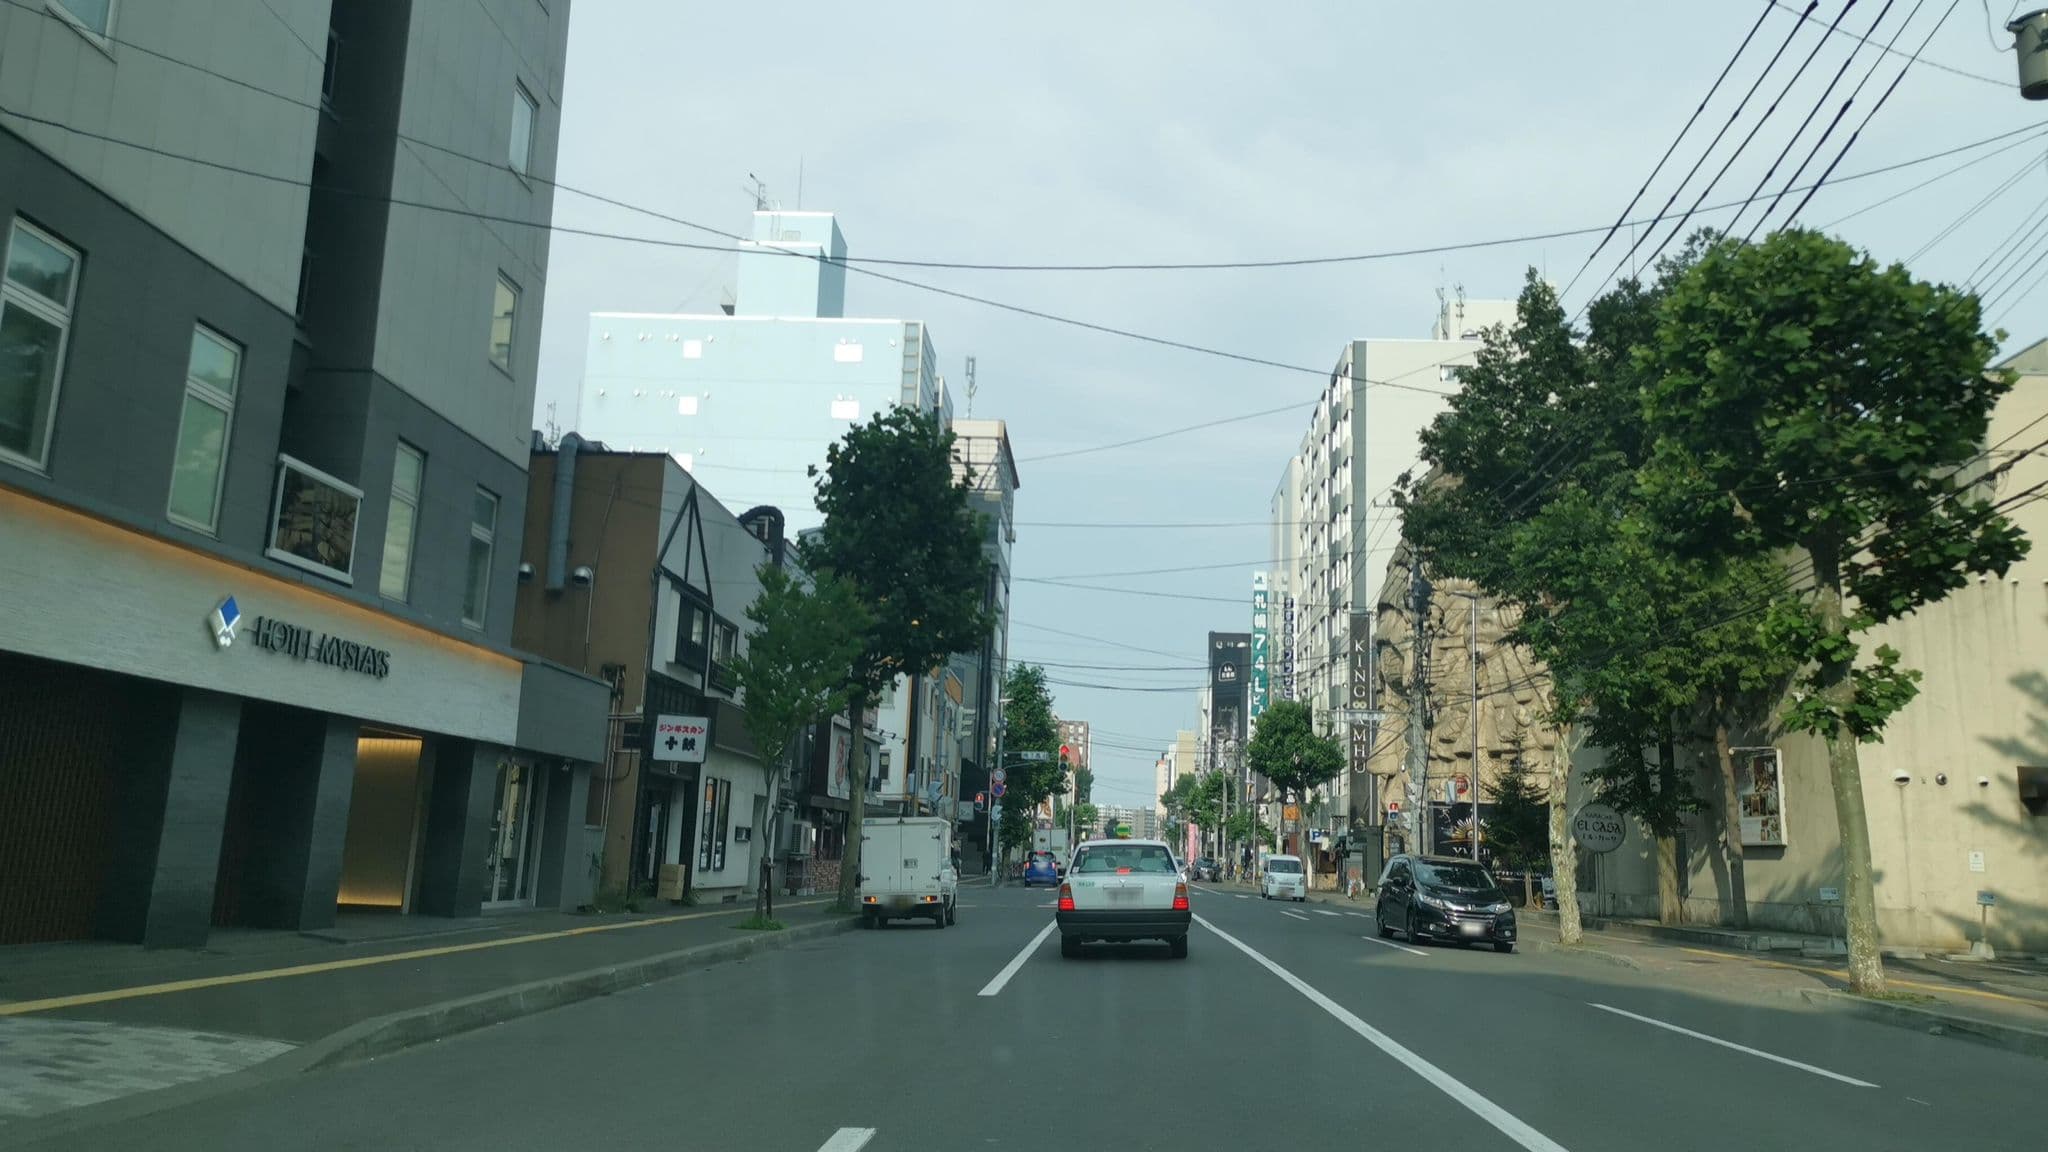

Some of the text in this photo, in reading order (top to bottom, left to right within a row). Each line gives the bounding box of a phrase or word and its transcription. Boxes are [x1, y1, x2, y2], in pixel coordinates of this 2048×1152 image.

[254, 616, 391, 680] HOTEL MYSTAYS
[1353, 639, 1366, 698] KING
[1312, 831, 1321, 840] P
